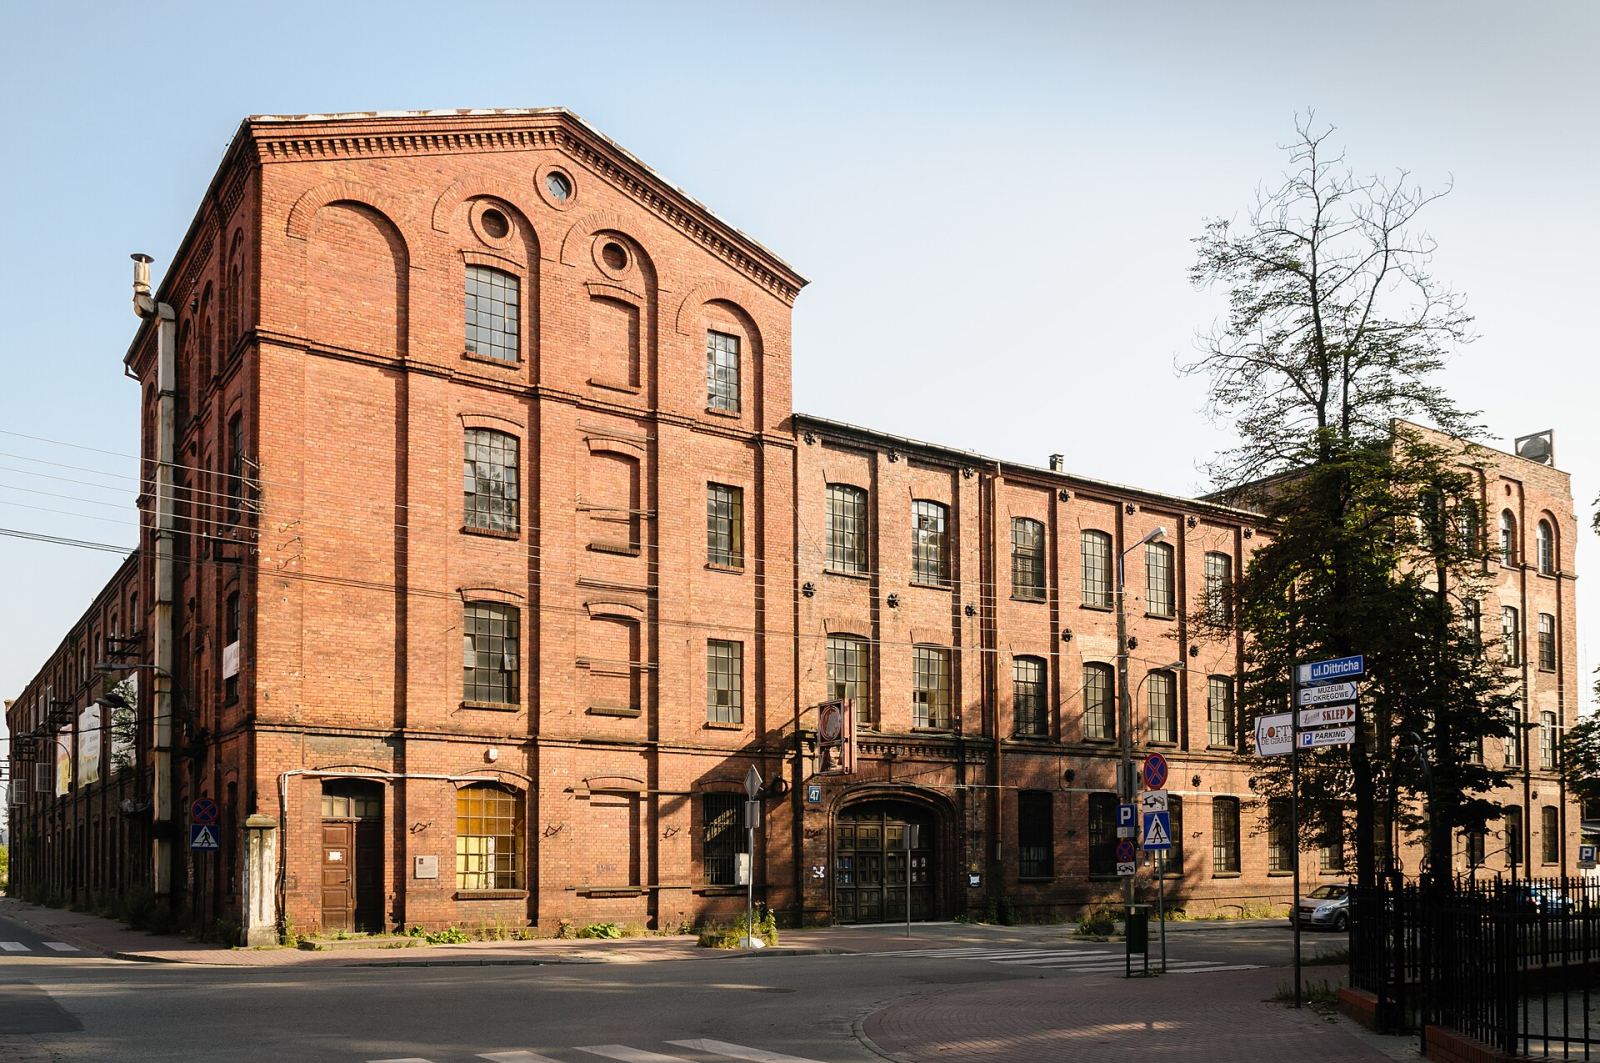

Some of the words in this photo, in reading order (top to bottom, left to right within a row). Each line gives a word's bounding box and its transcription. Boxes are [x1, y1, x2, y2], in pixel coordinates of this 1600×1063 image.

[1313, 660, 1359, 677] ul.Dittricha
[1318, 684, 1344, 694] MUZEUM
[1322, 708, 1346, 721] SKLEP
[1304, 734, 1311, 745] P
[1314, 730, 1346, 740] PARKING
[810, 790, 819, 801] 47
[1120, 807, 1131, 825] P
[1582, 847, 1592, 859] P
